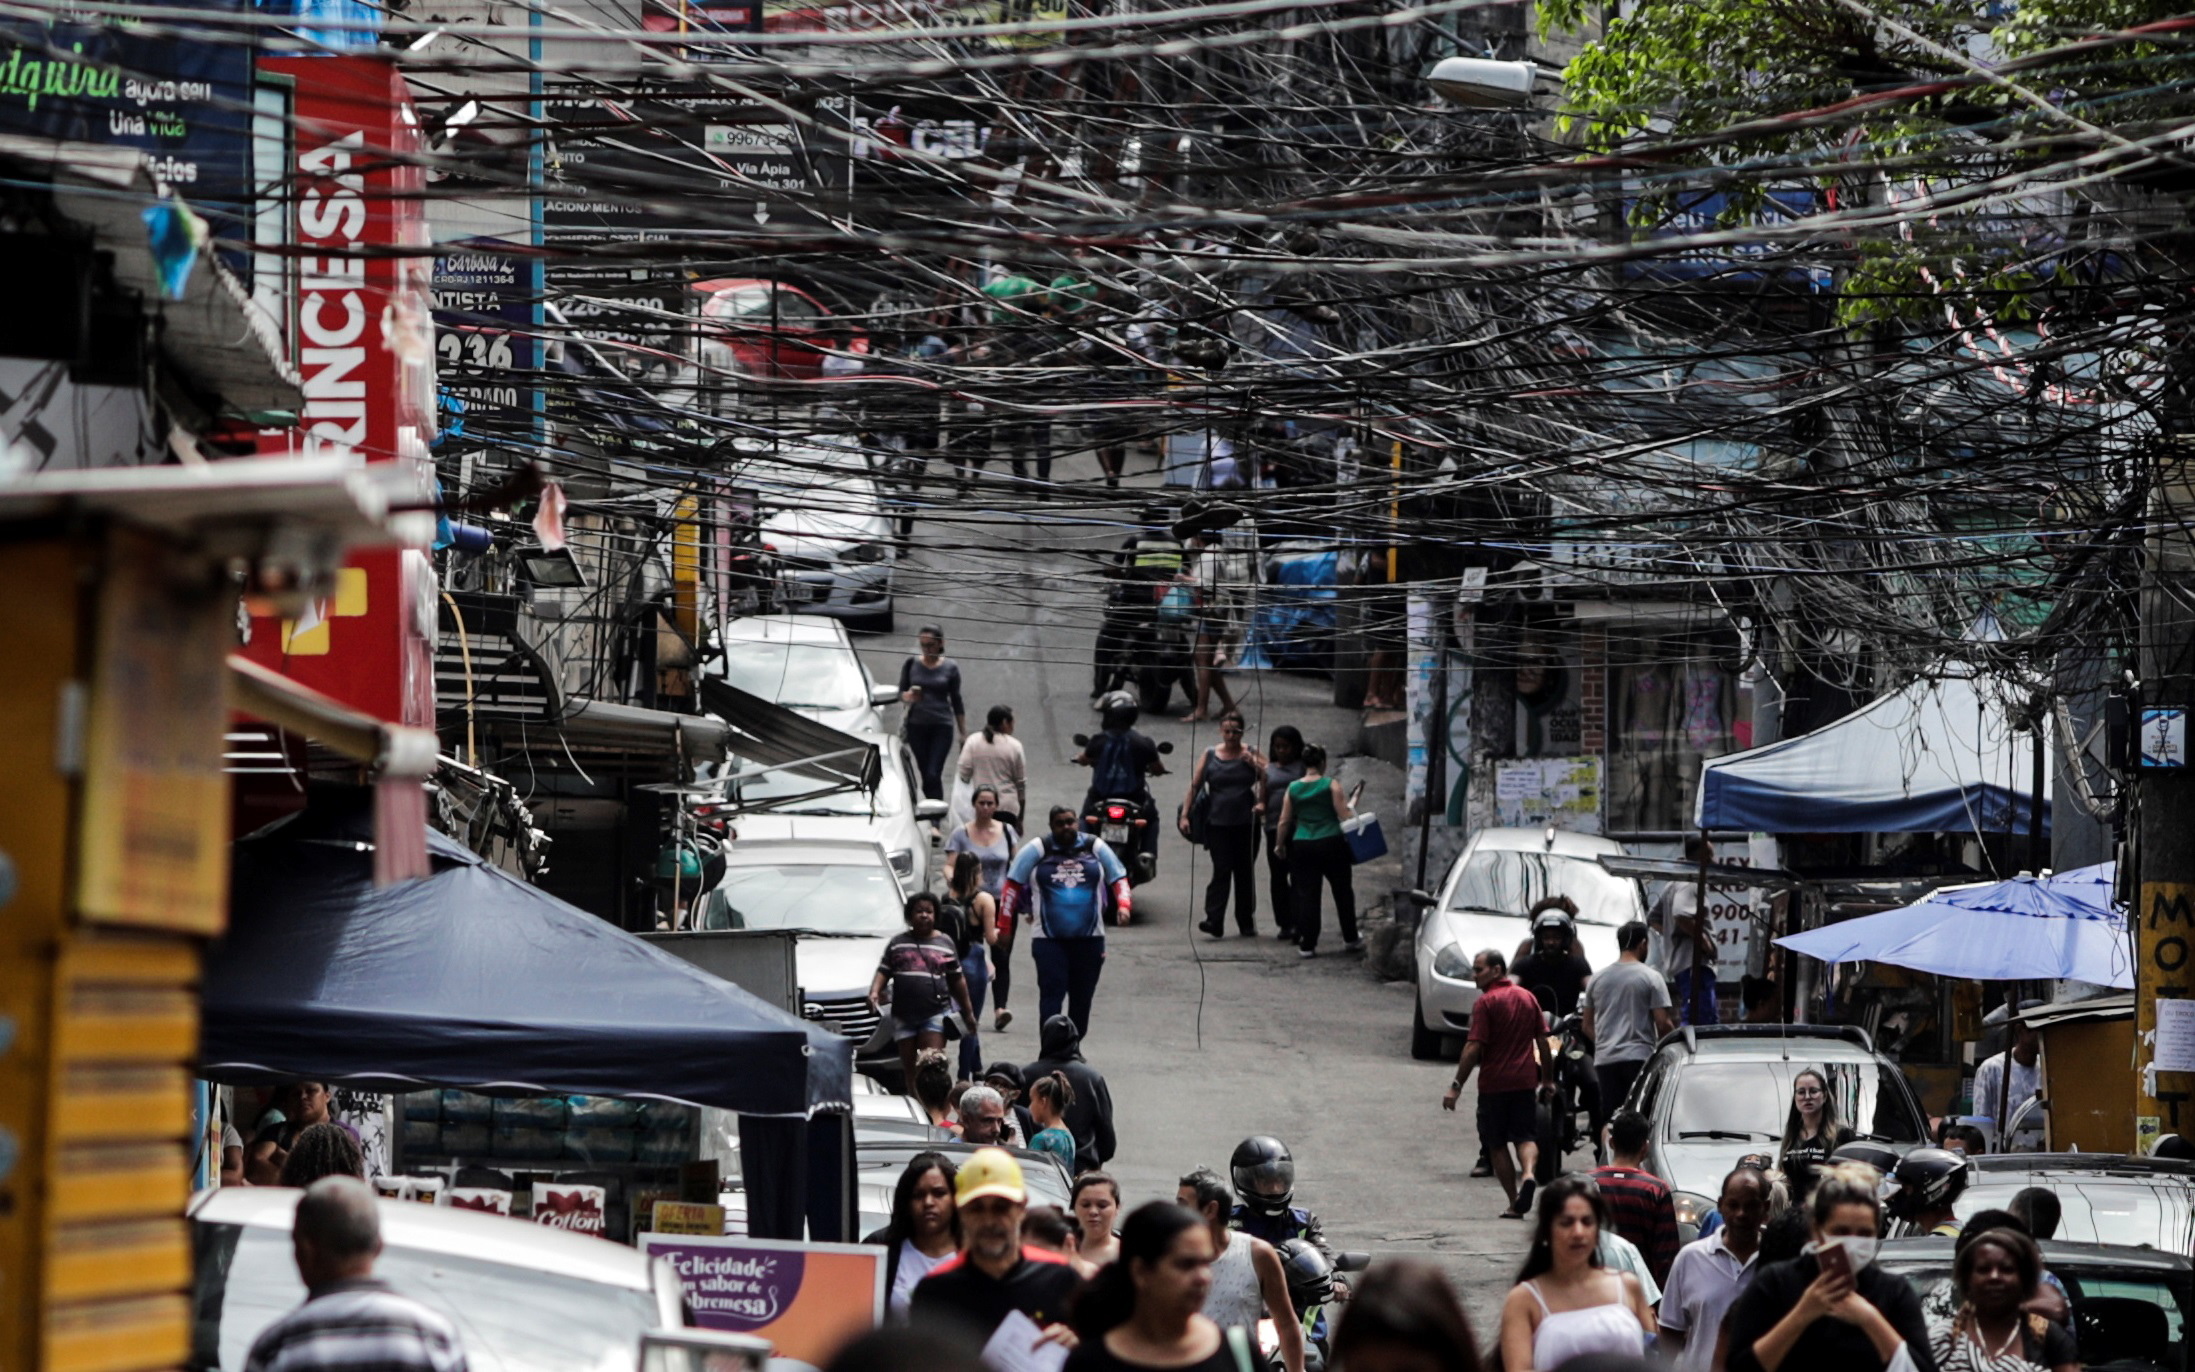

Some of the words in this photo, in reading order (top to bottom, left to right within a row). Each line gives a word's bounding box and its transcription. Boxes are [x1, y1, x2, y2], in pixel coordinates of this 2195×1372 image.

[148, 156, 197, 183] icios
[736, 162, 759, 175] Via
[299, 130, 368, 468] RINCESA
[430, 289, 502, 312] NTISTA
[663, 1251, 766, 1279] Felicidade
[699, 1274, 746, 1293] sabor
[685, 1291, 767, 1316] bremesa
